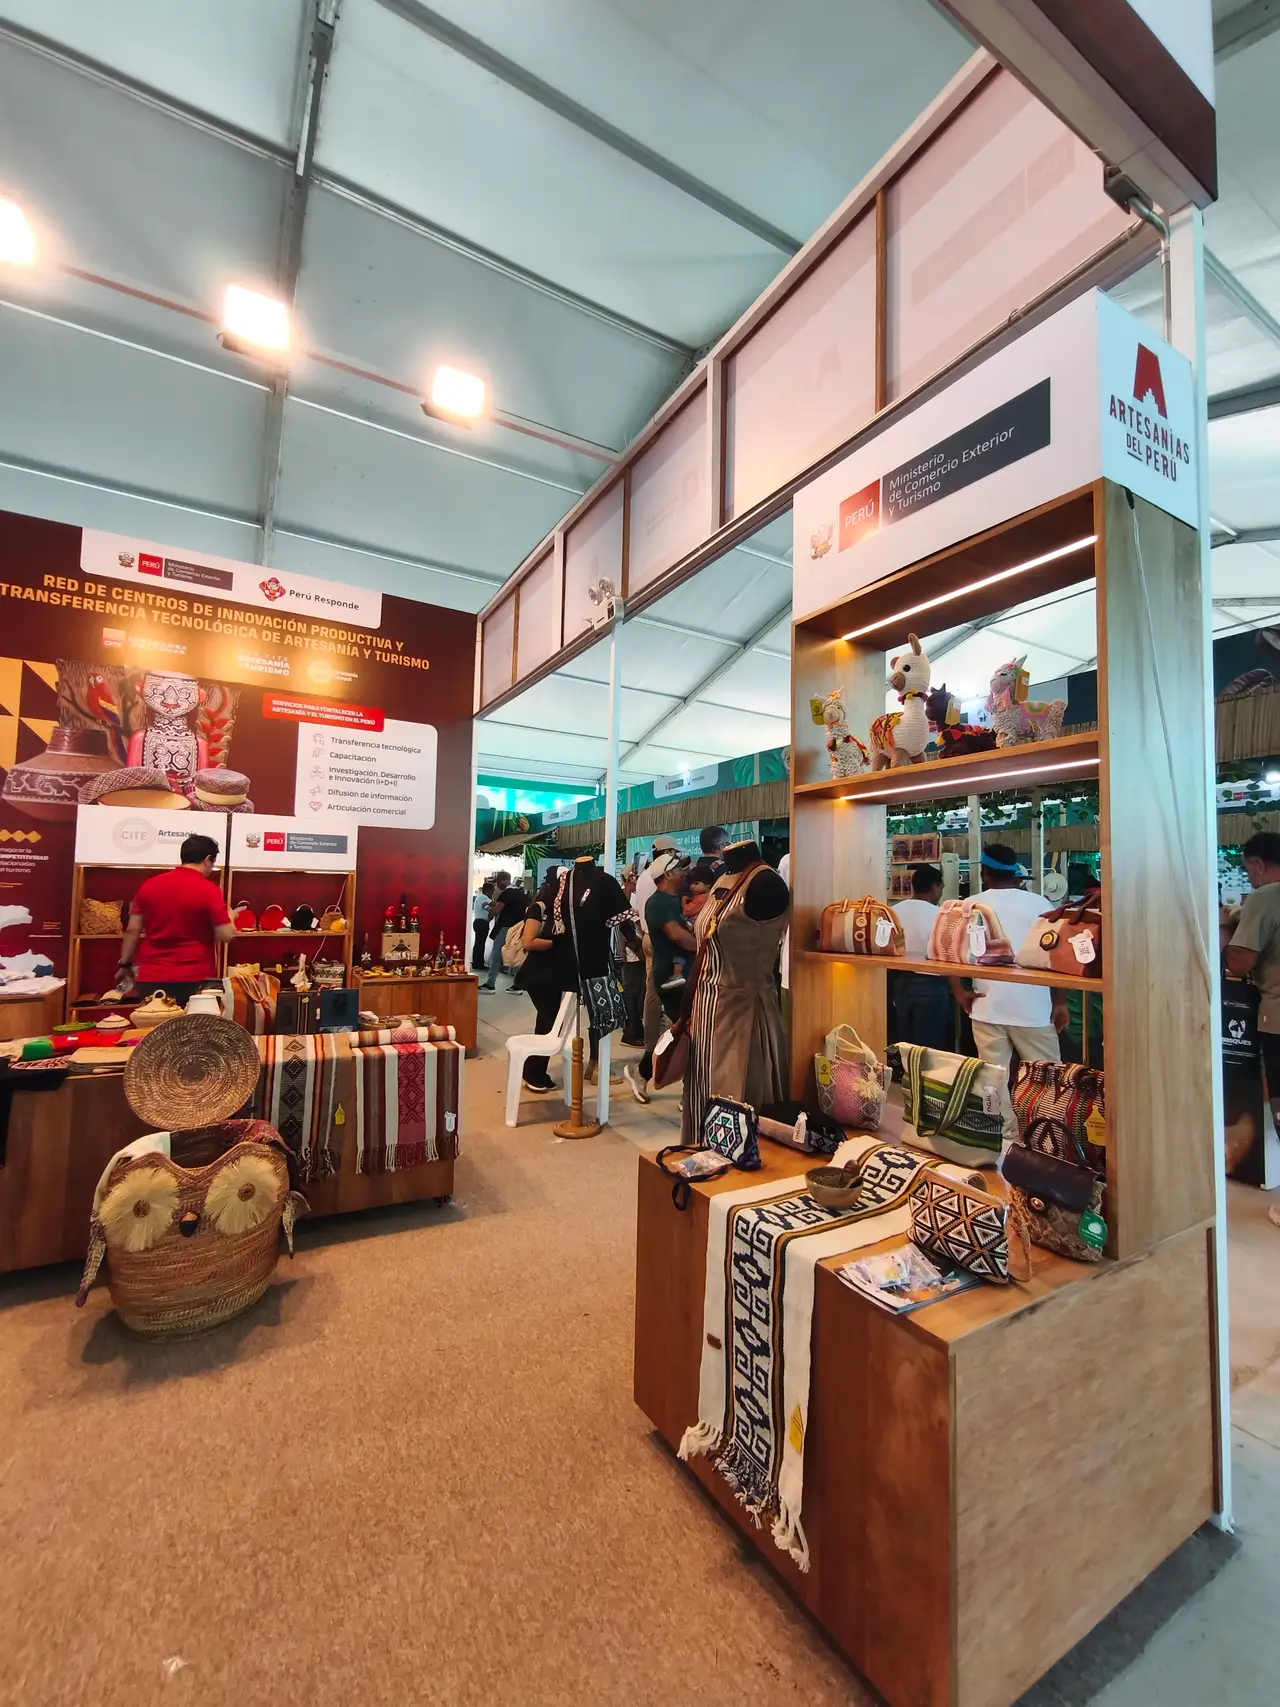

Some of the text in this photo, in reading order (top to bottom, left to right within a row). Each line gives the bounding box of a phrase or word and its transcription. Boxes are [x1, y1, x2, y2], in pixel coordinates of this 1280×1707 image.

[1126, 433, 1143, 455] DEL
[889, 425, 1015, 503] de Comercio Exterior
[1145, 444, 1177, 482] PERÚ
[889, 453, 945, 491] Ministerio
[888, 481, 941, 518] y Turismo
[844, 499, 875, 529] PERÚ
[142, 560, 160, 569] PERÚ
[167, 562, 195, 571] Ministerio
[172, 572, 193, 580] Turismo
[175, 568, 200, 577] Comercio
[289, 589, 360, 611] Perú Responde
[43, 574, 404, 652] RED DE CENTROS DE INNOVACIÓN PRODUCTIVA Y
[0, 583, 430, 671] TRANSFERENCIA TECNOLÓGICA DE ARTESANÍA Y TURISMO
[272, 700, 304, 709] SERVICIOS
[320, 706, 356, 716] FORTALECER
[272, 706, 306, 716] ARTESANÍA
[319, 713, 345, 721] TURISMO
[331, 737, 421, 754] Transferencia tecnológica
[329, 752, 377, 763] Capacitación
[329, 767, 416, 781] Investigación, Desarrollo
[334, 775, 375, 784] Innovación
[328, 789, 359, 798] Difusión
[370, 792, 413, 802] información
[327, 803, 406, 816] Articulación comercial
[121, 830, 147, 840] CITE
